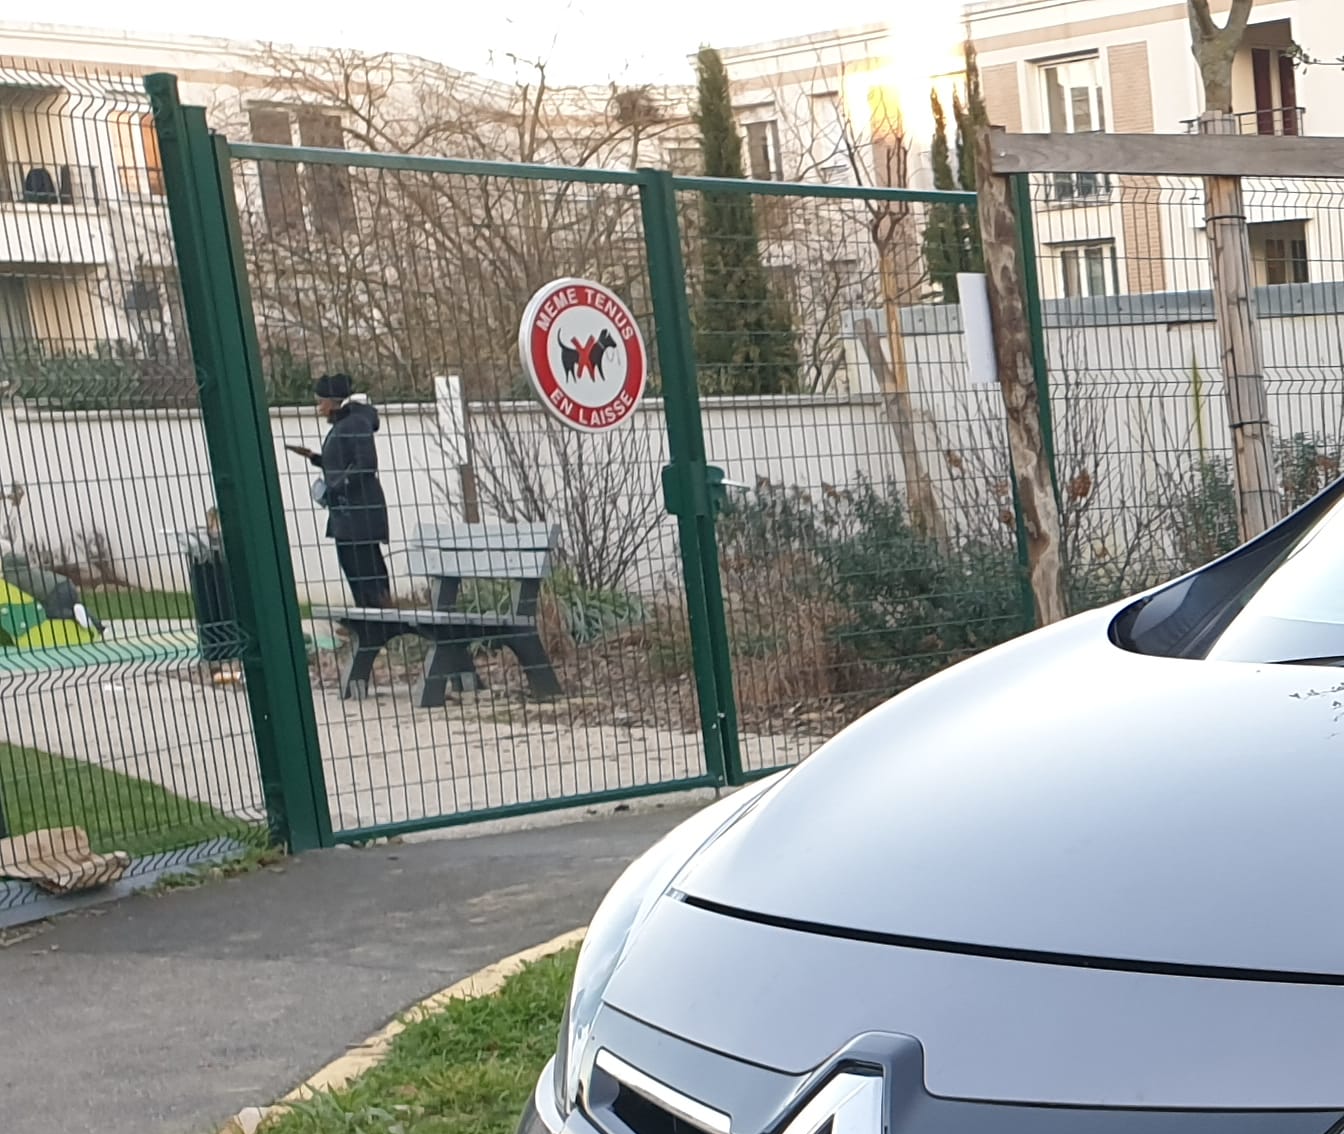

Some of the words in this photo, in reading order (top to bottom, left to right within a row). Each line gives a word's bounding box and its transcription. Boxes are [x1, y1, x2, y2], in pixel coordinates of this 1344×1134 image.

[536, 288, 578, 331] MEME
[585, 289, 634, 340] TENUS
[550, 389, 573, 415] EN
[579, 389, 633, 425] LAISSE
